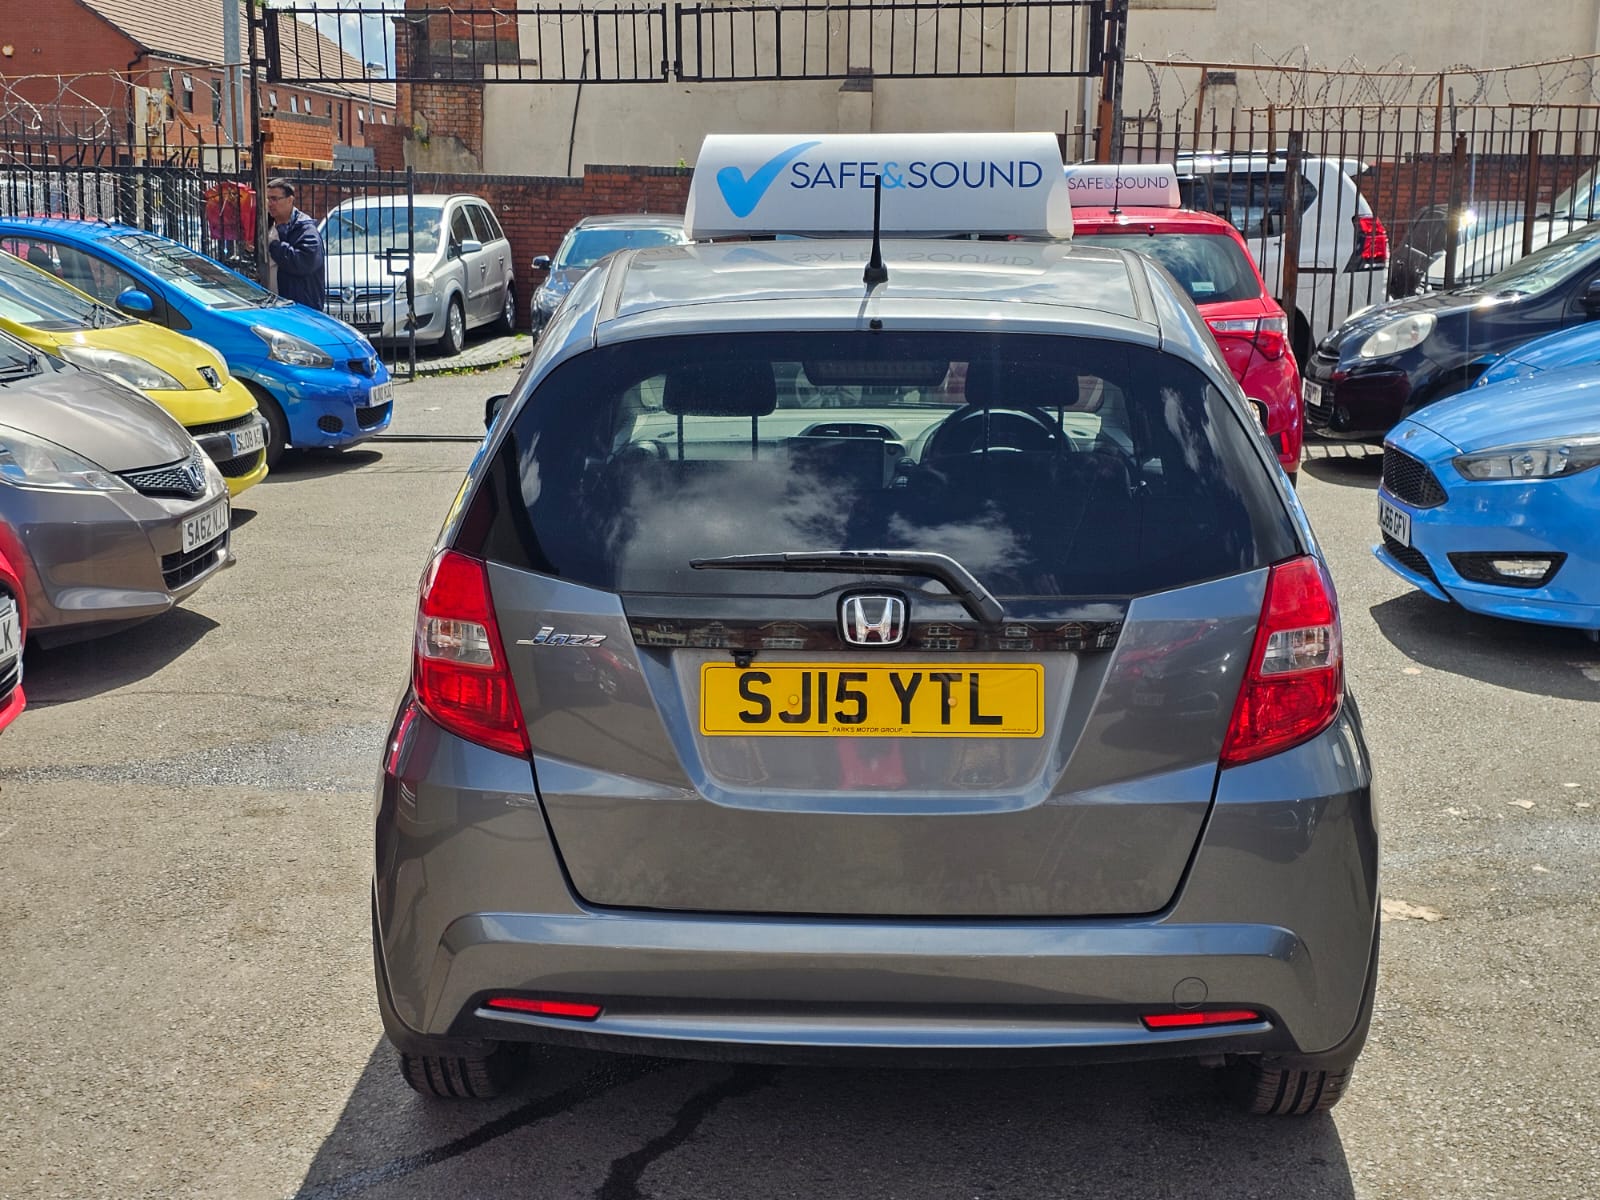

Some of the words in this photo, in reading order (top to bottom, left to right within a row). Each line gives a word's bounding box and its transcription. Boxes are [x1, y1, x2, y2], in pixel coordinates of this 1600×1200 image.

[790, 161, 1043, 189] SAFE&SOUND
[1067, 176, 1169, 190] SAFE&SOUND
[187, 514, 211, 546] SA62
[738, 671, 868, 725] SJ15
[889, 672, 1003, 725] YTL
